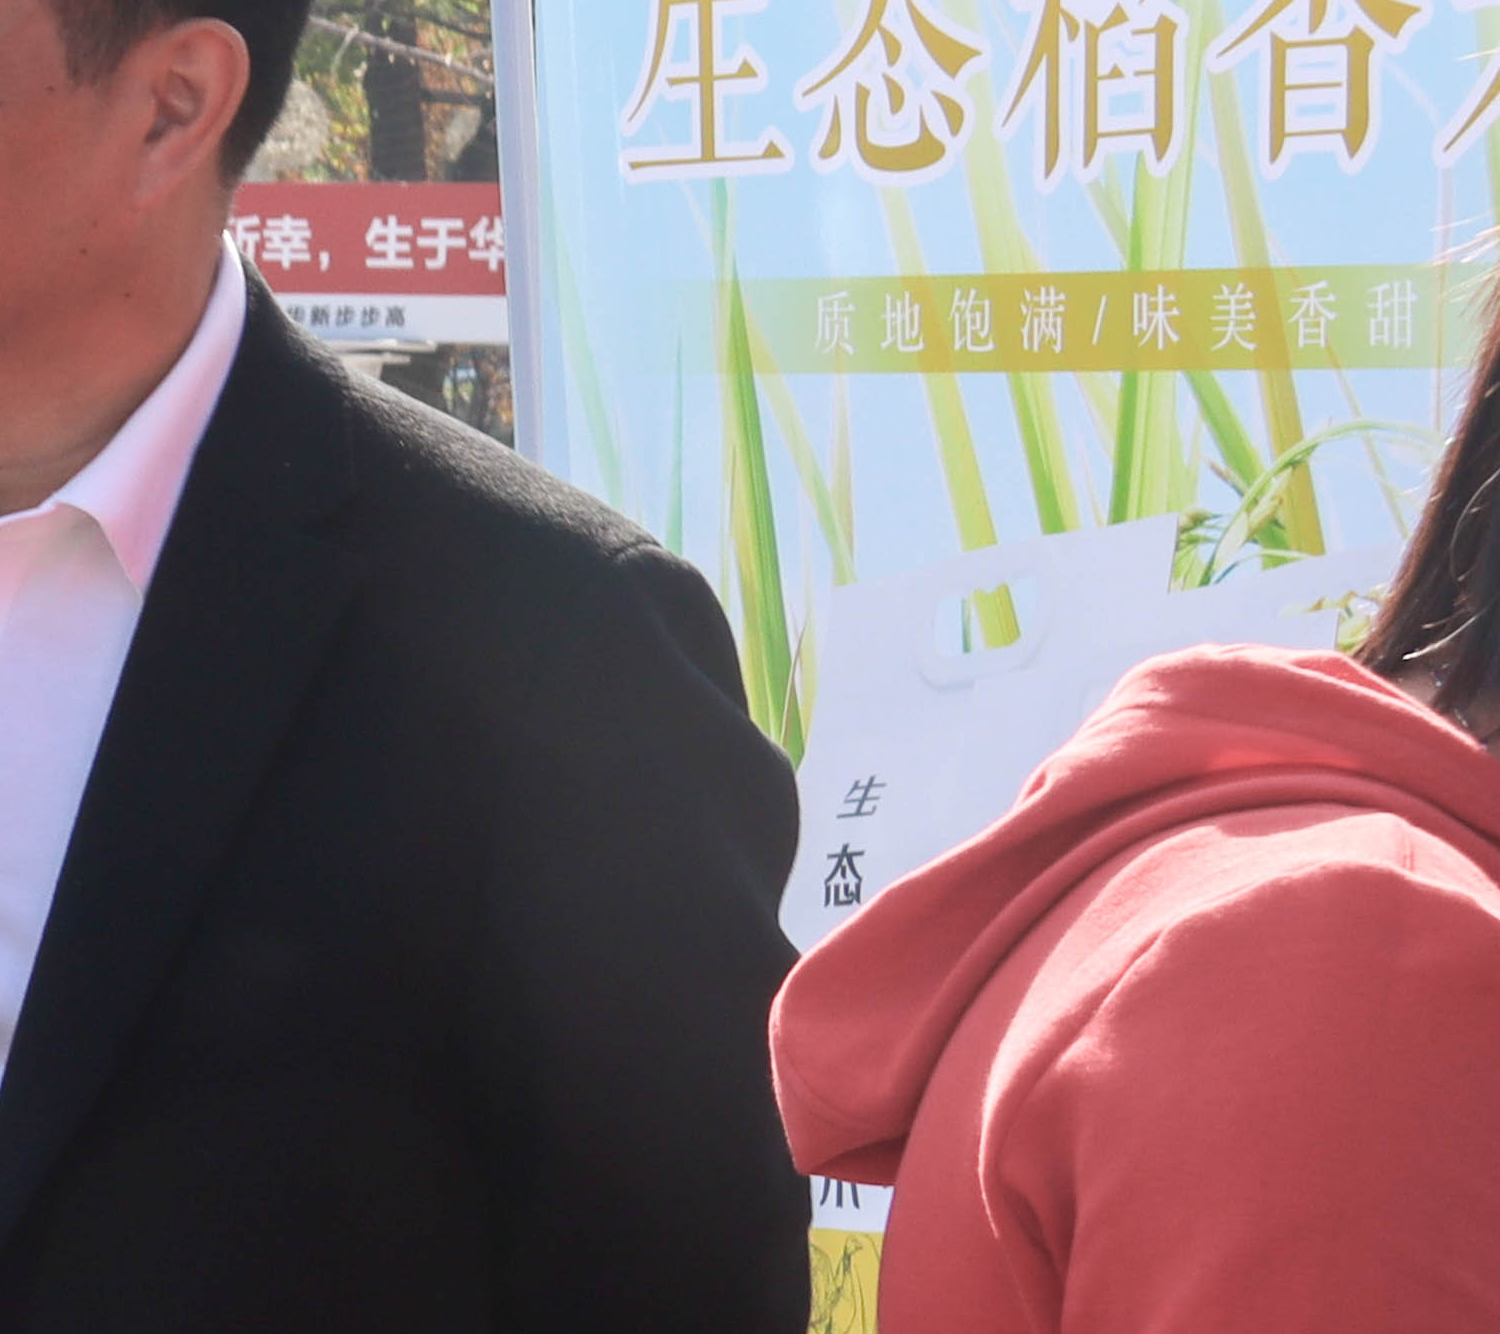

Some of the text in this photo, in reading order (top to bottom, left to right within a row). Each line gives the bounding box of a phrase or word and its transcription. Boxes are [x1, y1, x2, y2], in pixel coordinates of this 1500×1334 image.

[812, 279, 1417, 356] 质地饱满/味美香甜
[824, 775, 886, 908] 生态
